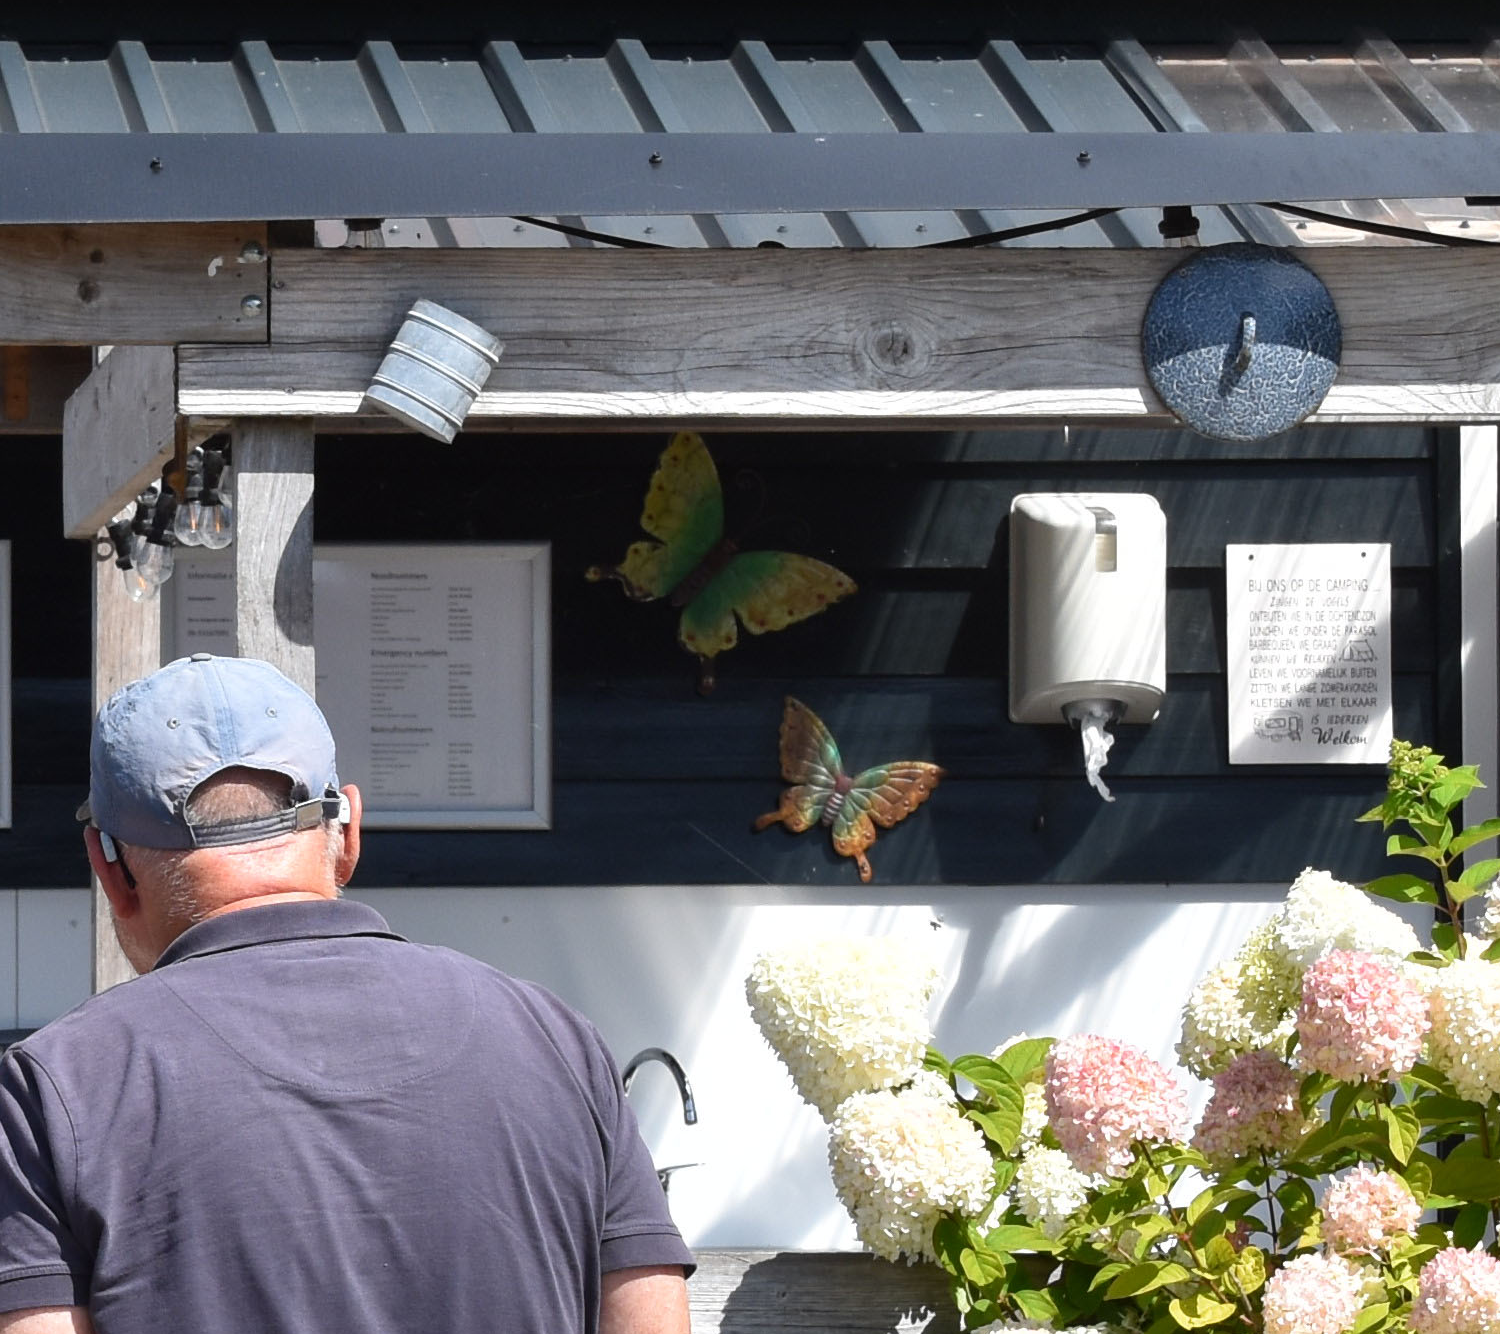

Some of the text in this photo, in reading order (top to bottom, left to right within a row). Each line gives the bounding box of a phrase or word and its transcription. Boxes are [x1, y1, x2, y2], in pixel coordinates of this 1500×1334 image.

[1248, 578, 1369, 593] BIJ ONS OP DE CAMPING
[1315, 610, 1325, 622] DE
[1249, 668, 1273, 679] LEVEN
[1350, 668, 1377, 679] BUITEN
[1250, 682, 1278, 694] ZITTEN
[1250, 697, 1378, 708] KLETSEN WE MET ELKAAR
[1310, 714, 1370, 725] IS IEDEREEN
[1311, 727, 1368, 745] Welkom
